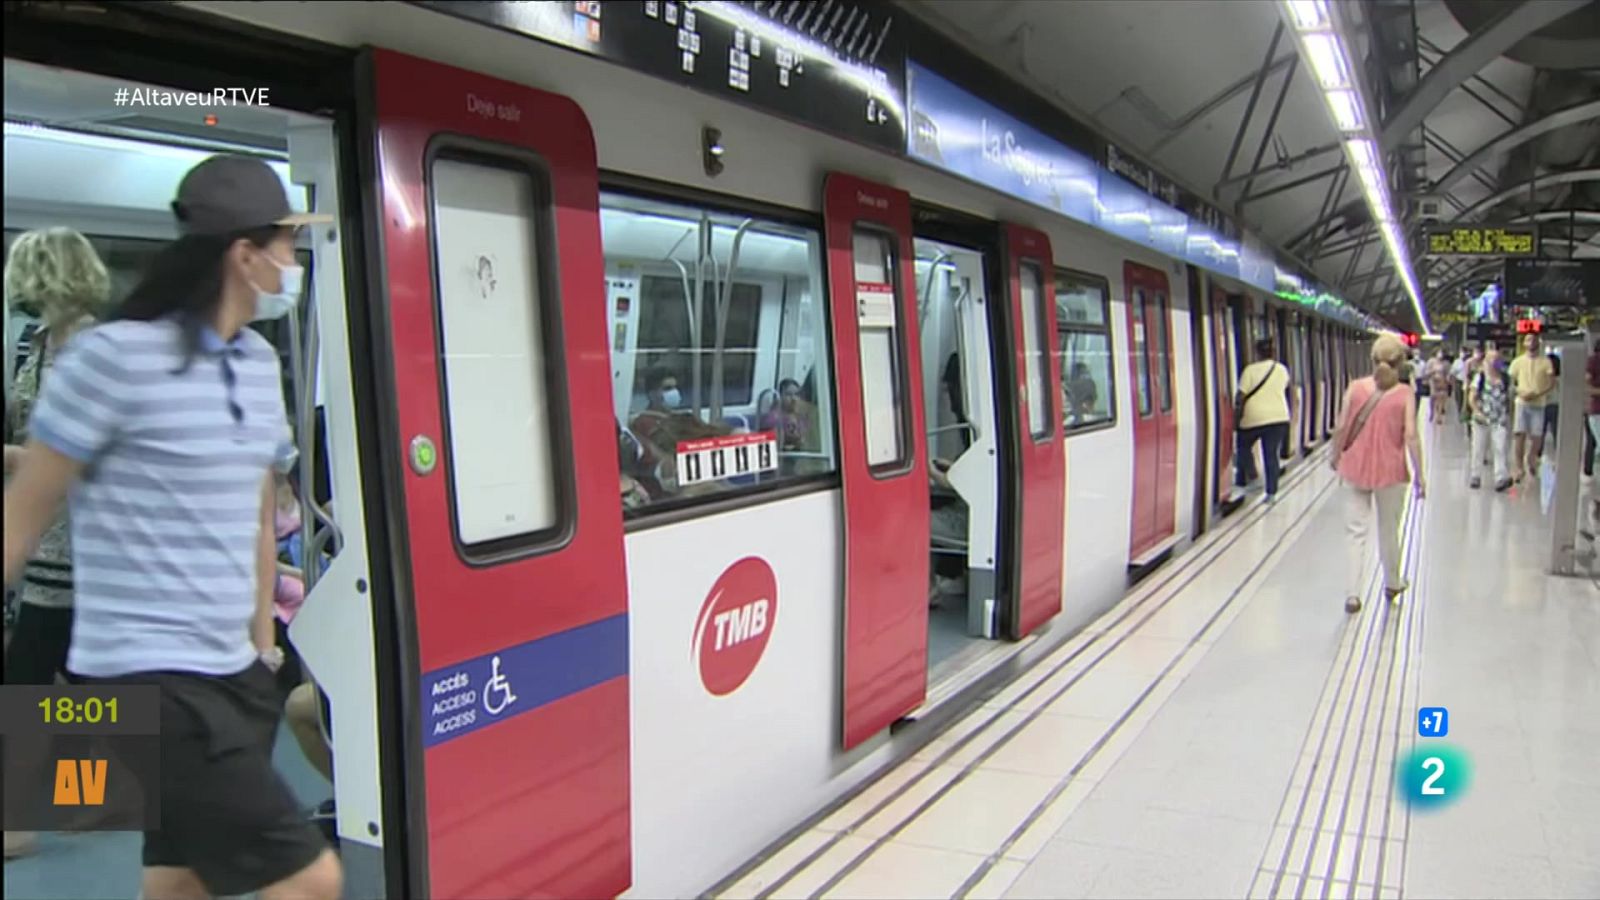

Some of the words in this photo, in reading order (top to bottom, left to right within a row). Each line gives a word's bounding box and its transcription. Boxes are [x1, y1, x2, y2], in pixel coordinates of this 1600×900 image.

[982, 118, 1001, 164] La
[714, 598, 769, 651] TMB
[432, 690, 476, 716] ACCESO
[432, 709, 476, 736] ACCESS
